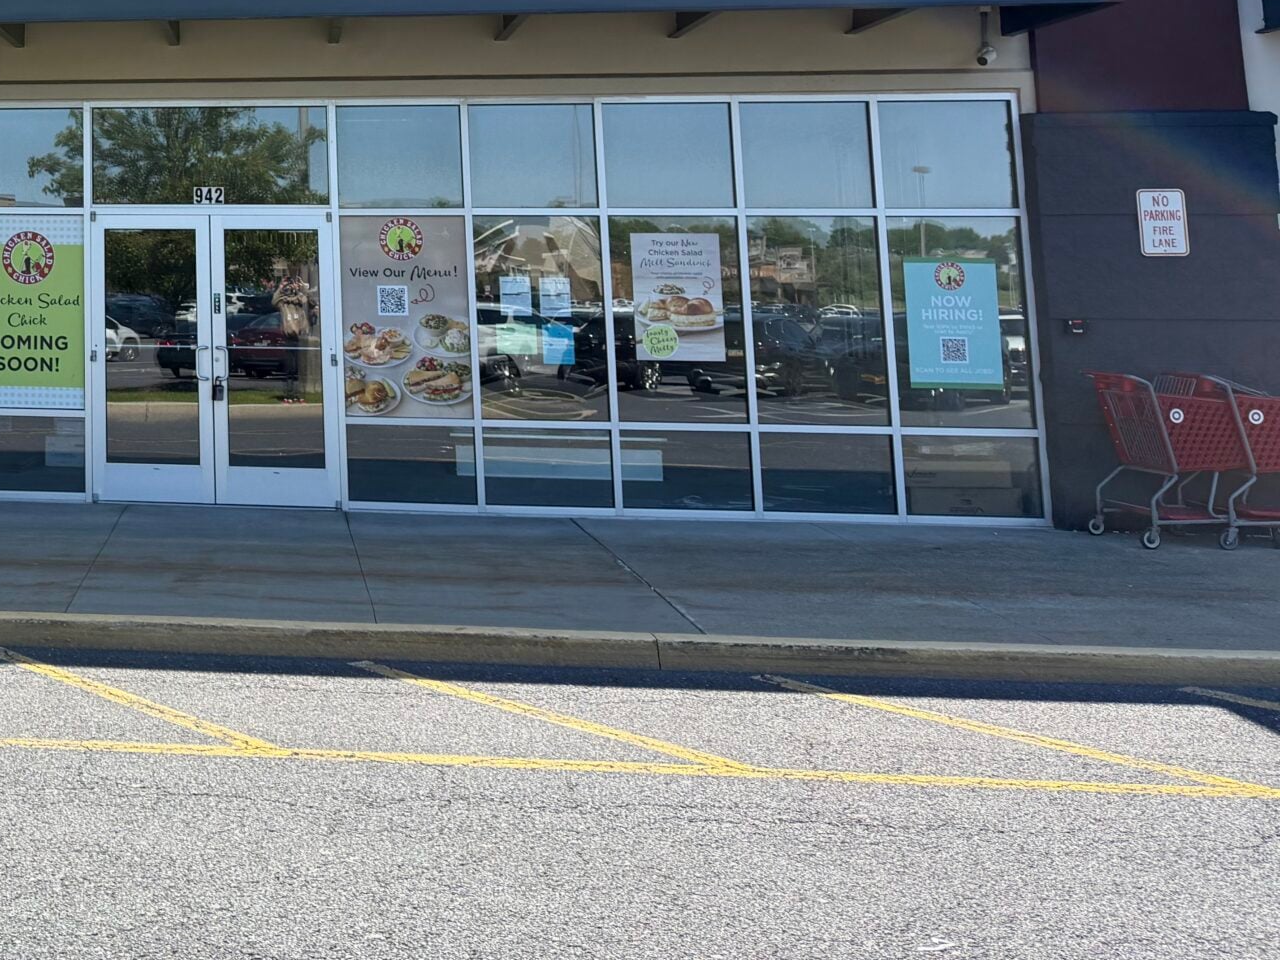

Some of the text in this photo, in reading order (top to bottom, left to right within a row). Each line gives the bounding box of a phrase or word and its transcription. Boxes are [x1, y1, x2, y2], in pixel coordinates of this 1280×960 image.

[195, 187, 223, 204] 942
[1152, 195, 1169, 207] NO
[1143, 209, 1181, 221] PARKING
[380, 218, 422, 245] CHICKEN SALAD
[1152, 226, 1174, 236] FIRE
[3, 232, 53, 266] CHICKEN SALAD
[1152, 238, 1177, 248] LANE
[388, 252, 415, 260] CHICK
[12, 272, 43, 284] CHICK
[349, 265, 458, 281] View Our Menu!
[37, 292, 81, 309] Salad
[931, 295, 971, 307] NOW
[7, 312, 48, 328] Chick
[921, 309, 983, 321] HIRING!
